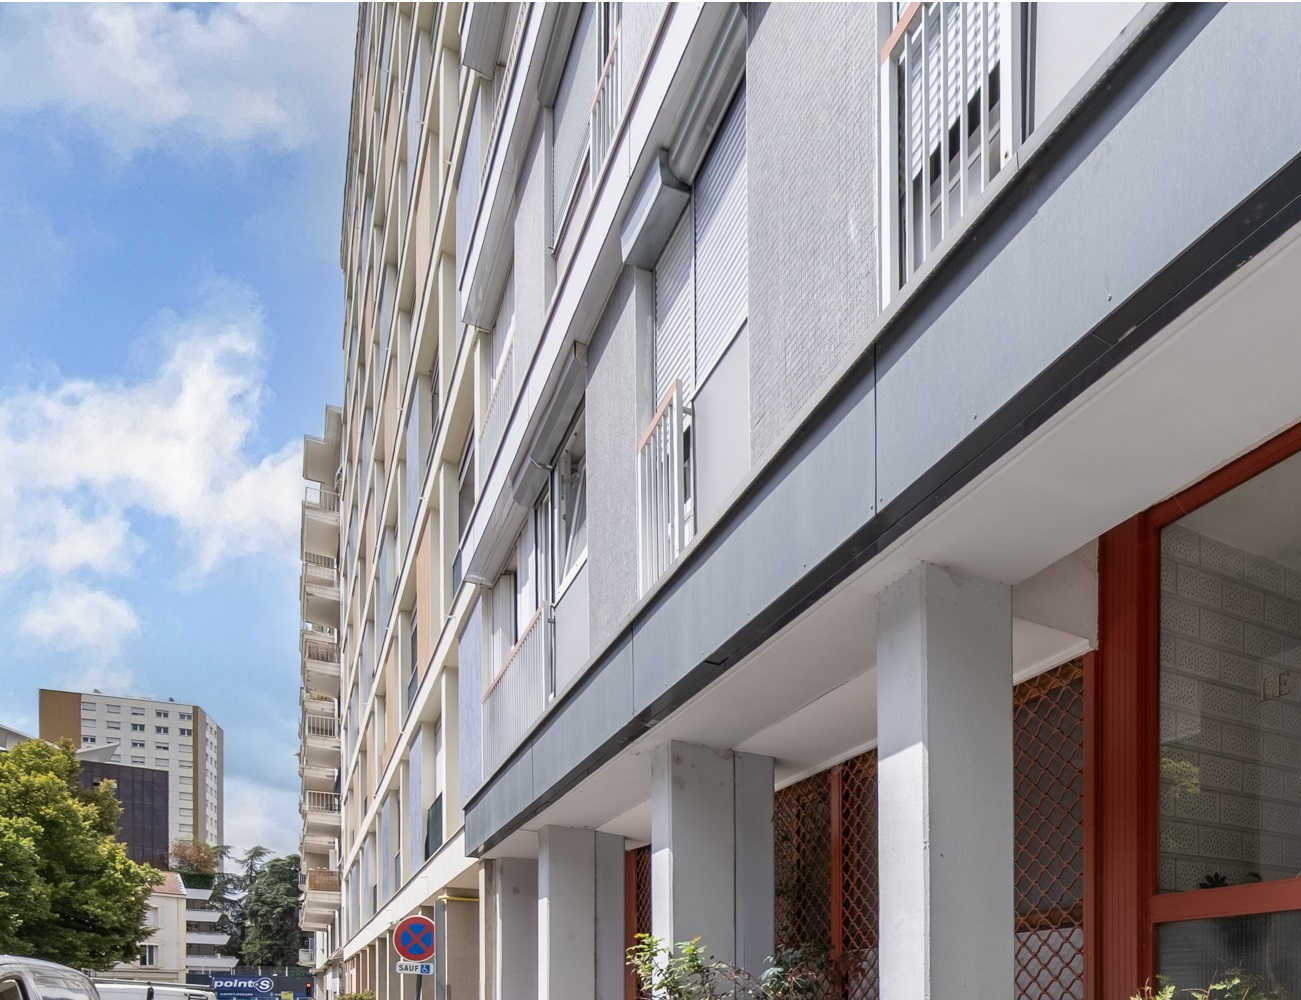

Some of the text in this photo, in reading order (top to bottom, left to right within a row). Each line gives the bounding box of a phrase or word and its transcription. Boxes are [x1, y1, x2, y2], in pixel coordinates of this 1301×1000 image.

[1260, 671, 1290, 702] LE
[399, 964, 419, 972] SAUF
[213, 979, 254, 990] point
